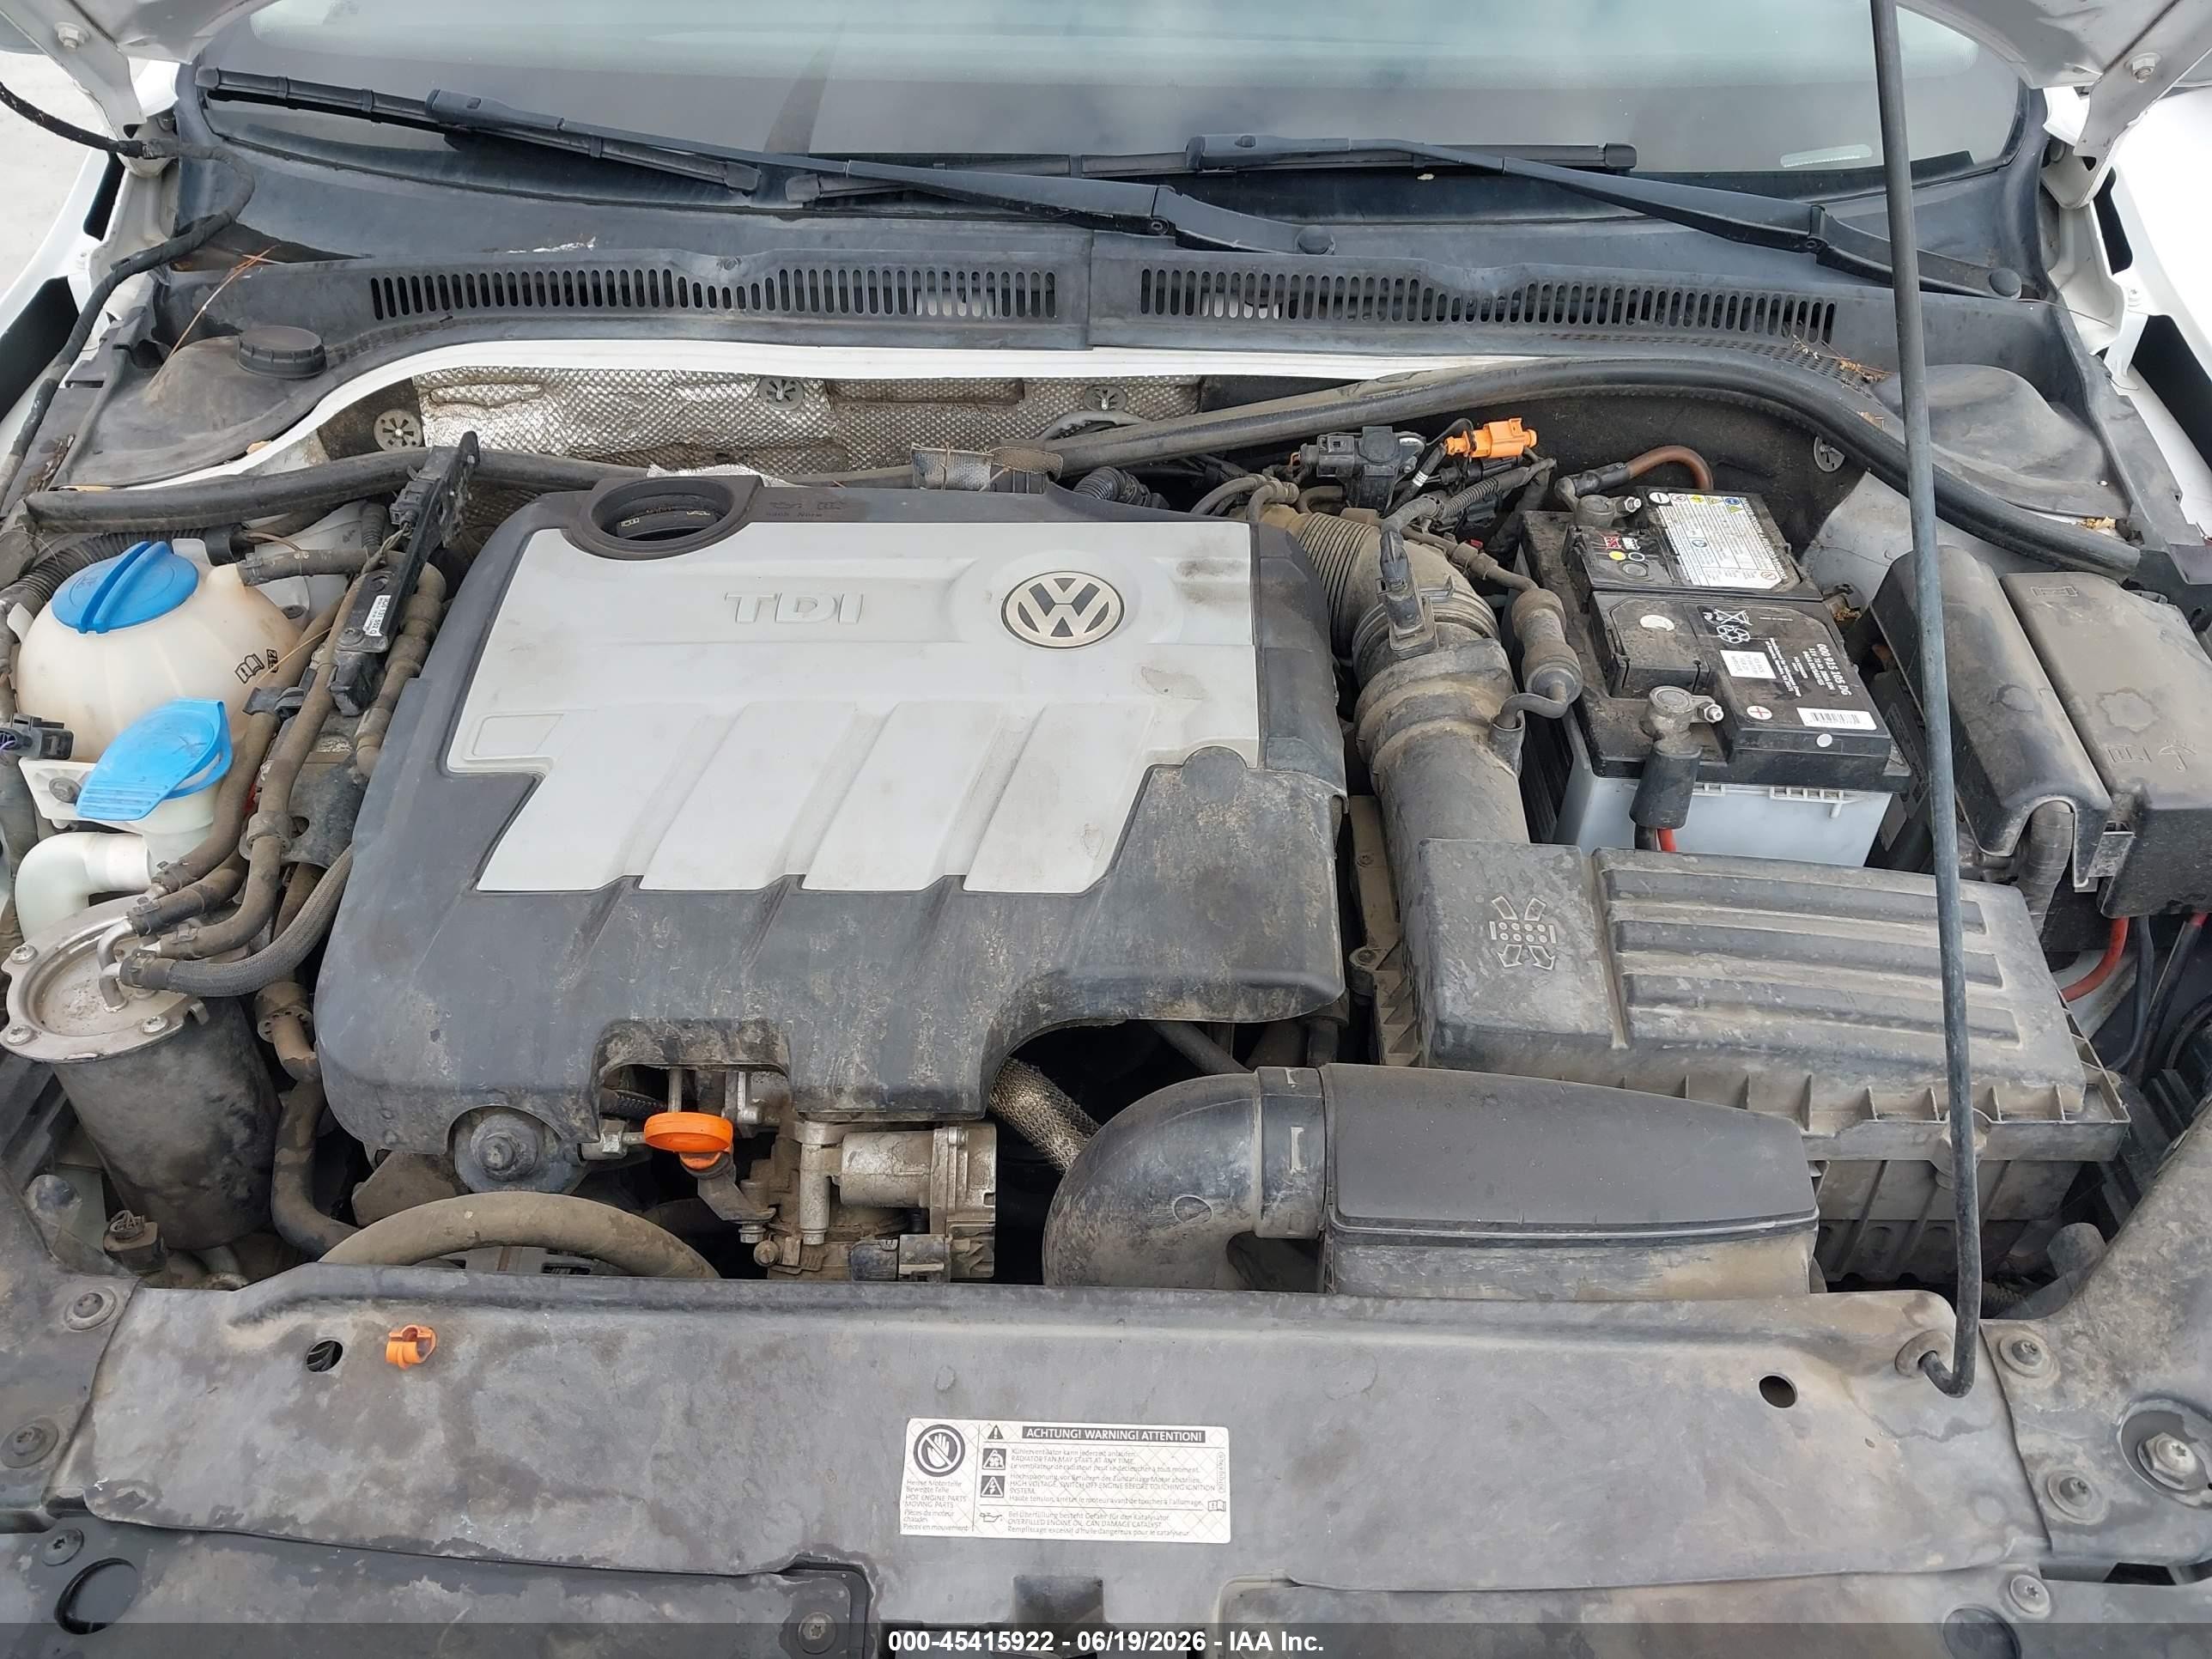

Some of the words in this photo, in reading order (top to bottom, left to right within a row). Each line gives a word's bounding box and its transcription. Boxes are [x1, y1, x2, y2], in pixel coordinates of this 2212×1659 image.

[725, 592, 864, 625] TDI
[1002, 570, 1124, 649] VW
[1816, 644, 1832, 657] 000
[1824, 657, 1838, 670] 915
[1831, 671, 1845, 684] 105
[1838, 685, 1852, 696] DG
[1026, 1428, 1081, 1438] ACHTUNG!
[1085, 1430, 1139, 1440] WARNING!
[1141, 1431, 1202, 1442] ATTENTION!
